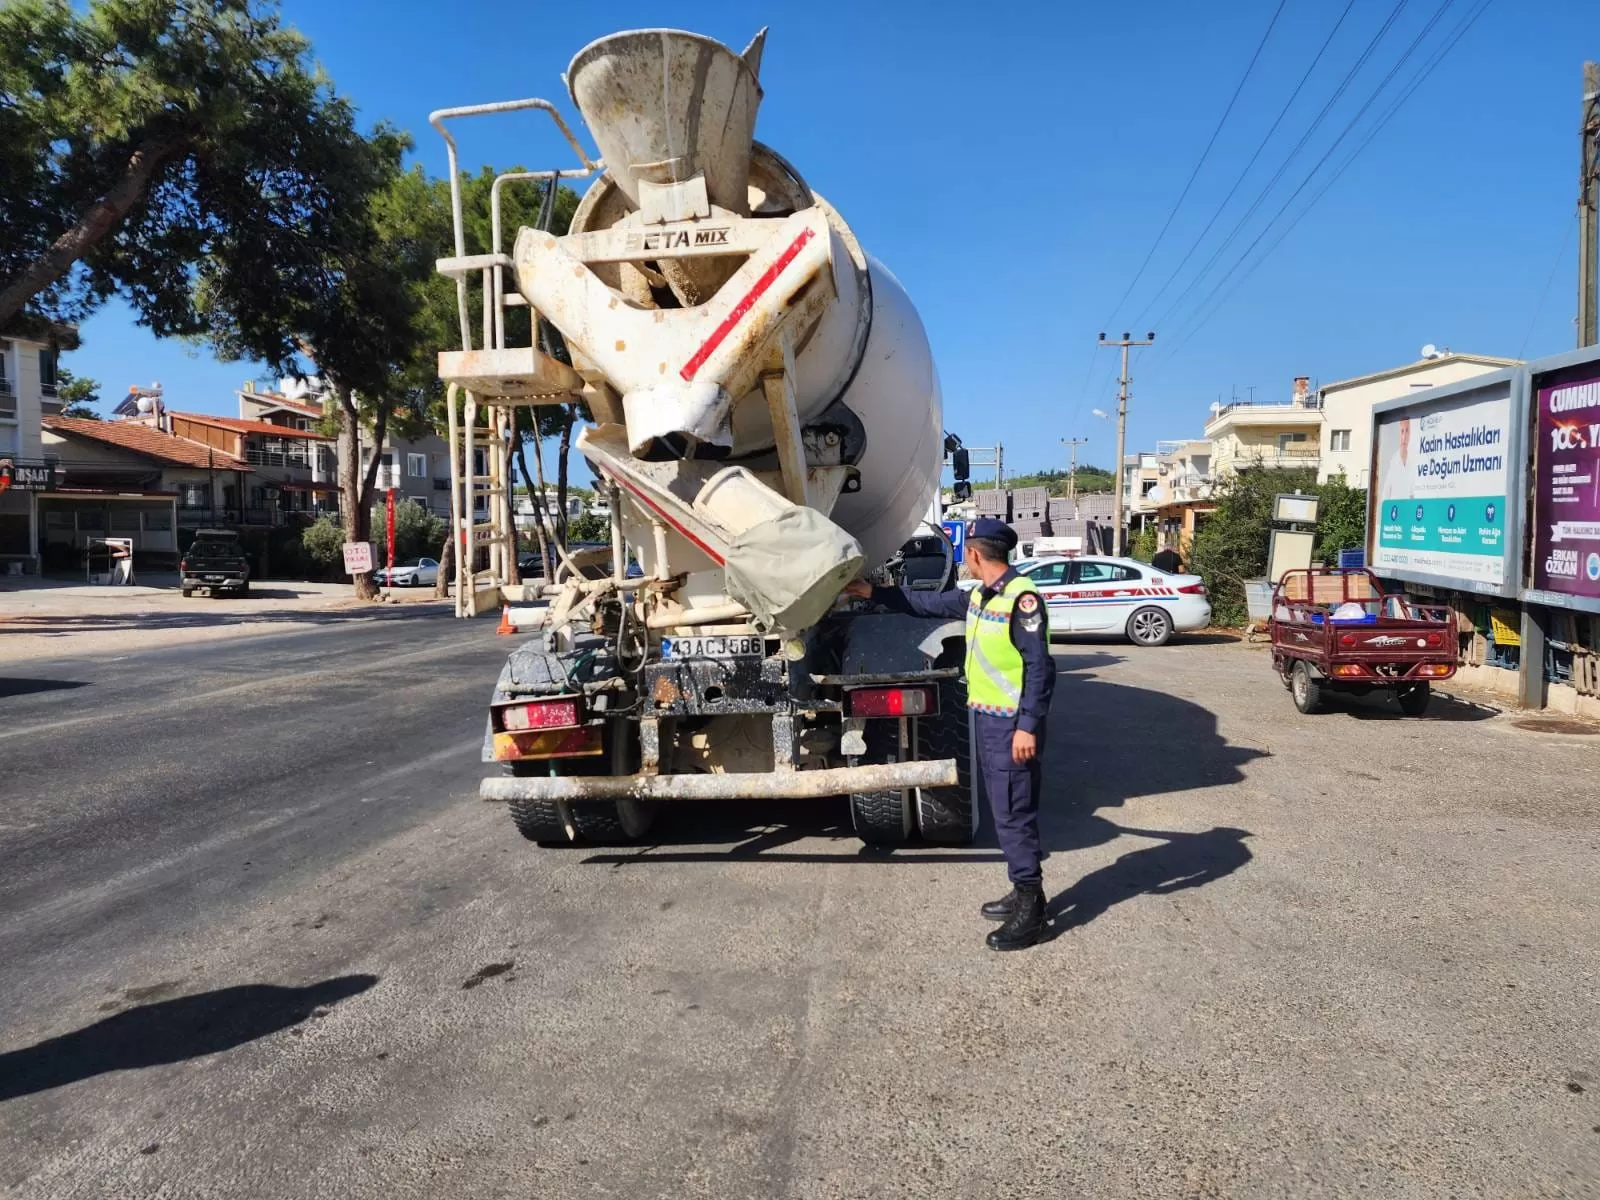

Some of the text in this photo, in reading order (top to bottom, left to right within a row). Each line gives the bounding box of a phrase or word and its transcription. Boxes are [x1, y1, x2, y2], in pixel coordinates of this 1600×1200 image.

[694, 229, 729, 244] MIX
[1550, 382, 1600, 413] CUMHU
[1420, 425, 1501, 454] Kadın Hastalıkları
[1589, 423, 1600, 448] Y
[1418, 454, 1502, 479] ve Doğum Uzmanı
[1553, 549, 1578, 561] ERKAN
